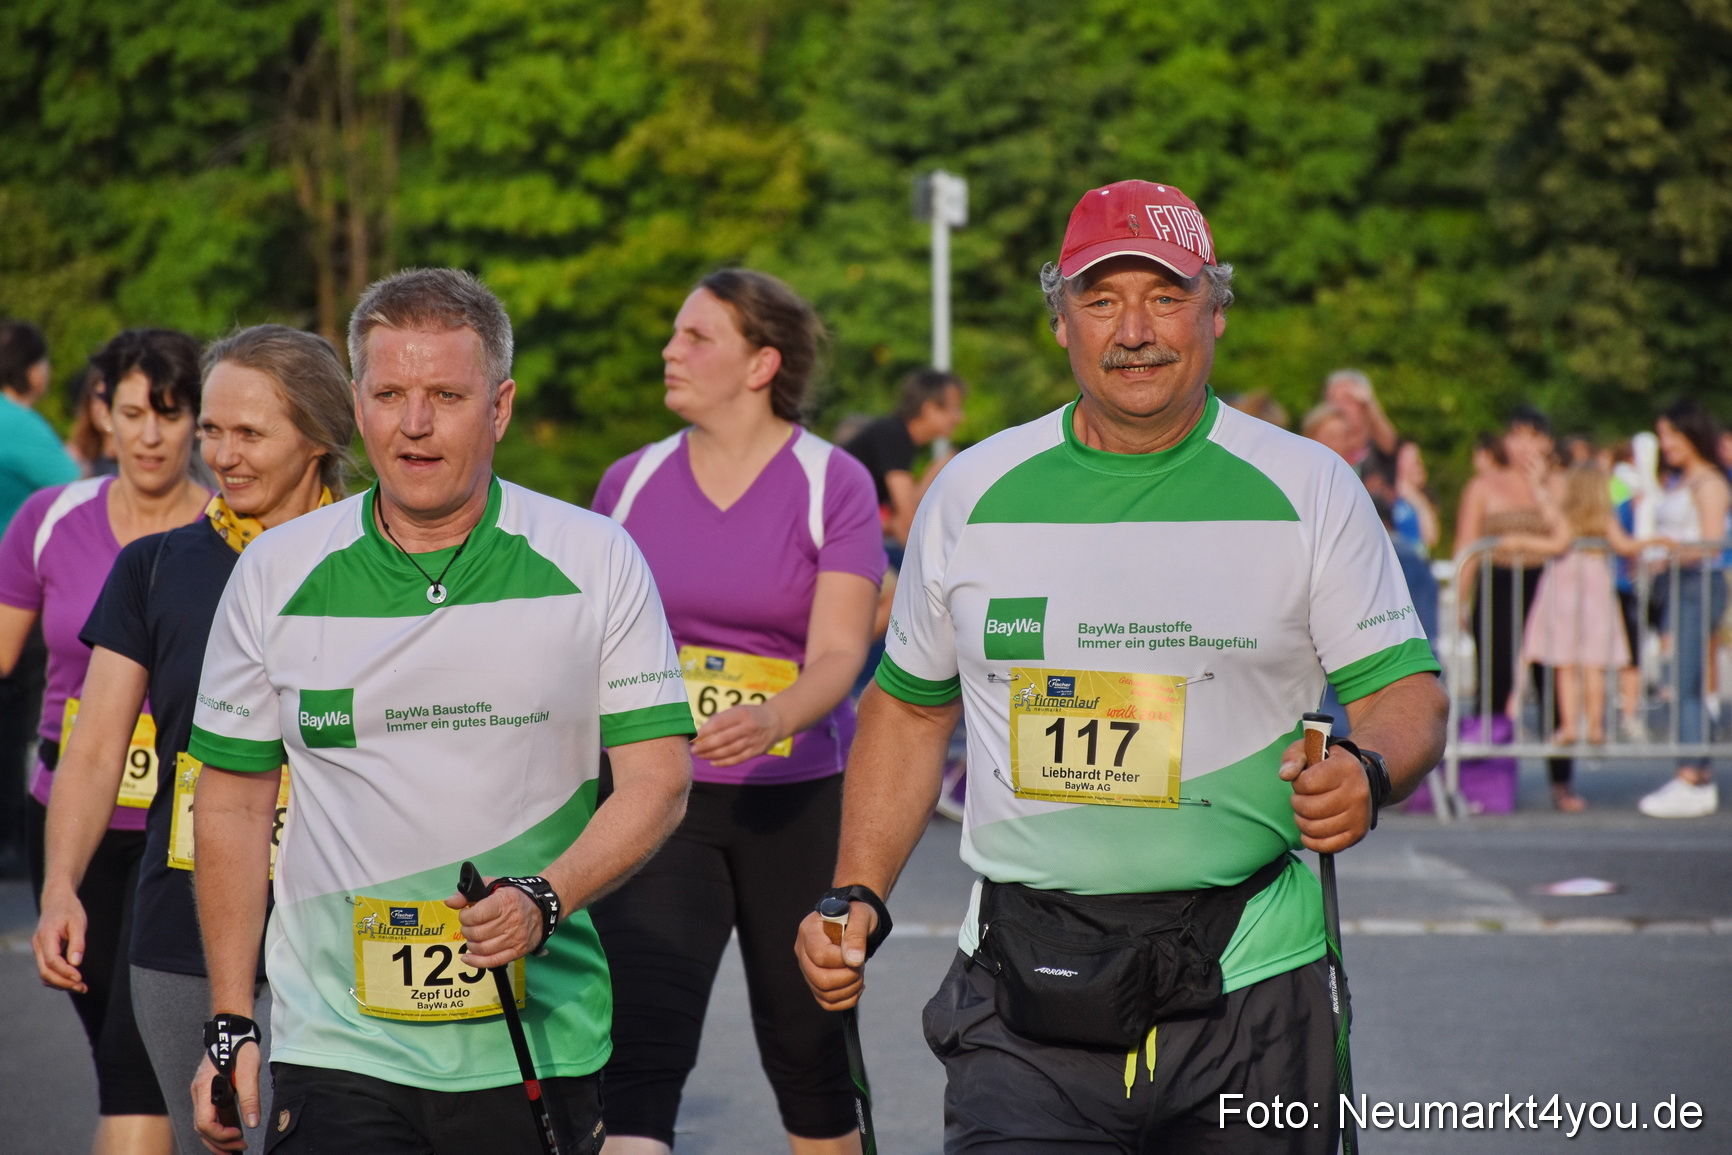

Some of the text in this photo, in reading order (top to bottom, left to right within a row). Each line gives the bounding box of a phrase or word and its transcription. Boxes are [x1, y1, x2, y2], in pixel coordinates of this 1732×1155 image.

[985, 618, 1041, 637] BayWa
[1077, 620, 1193, 637] BayWa Baustoffe
[1077, 635, 1258, 651] Immer ein gutes Baugefühl
[1033, 693, 1101, 709] firmenlauf
[385, 701, 493, 721] BayWa Baustoffe
[1106, 704, 1138, 720] walk
[299, 710, 351, 731] BayWa
[386, 710, 550, 733] Immer ein gutes Baugefühl
[1045, 717, 1140, 768] 117
[1041, 766, 1141, 784] Liebhardt Peter
[1064, 781, 1111, 792] BayWa AG
[377, 922, 446, 937] firmenlauf
[411, 987, 471, 1002] Zepf Udo
[417, 1000, 464, 1011] BayWa AG
[217, 1021, 230, 1060] LEKI
